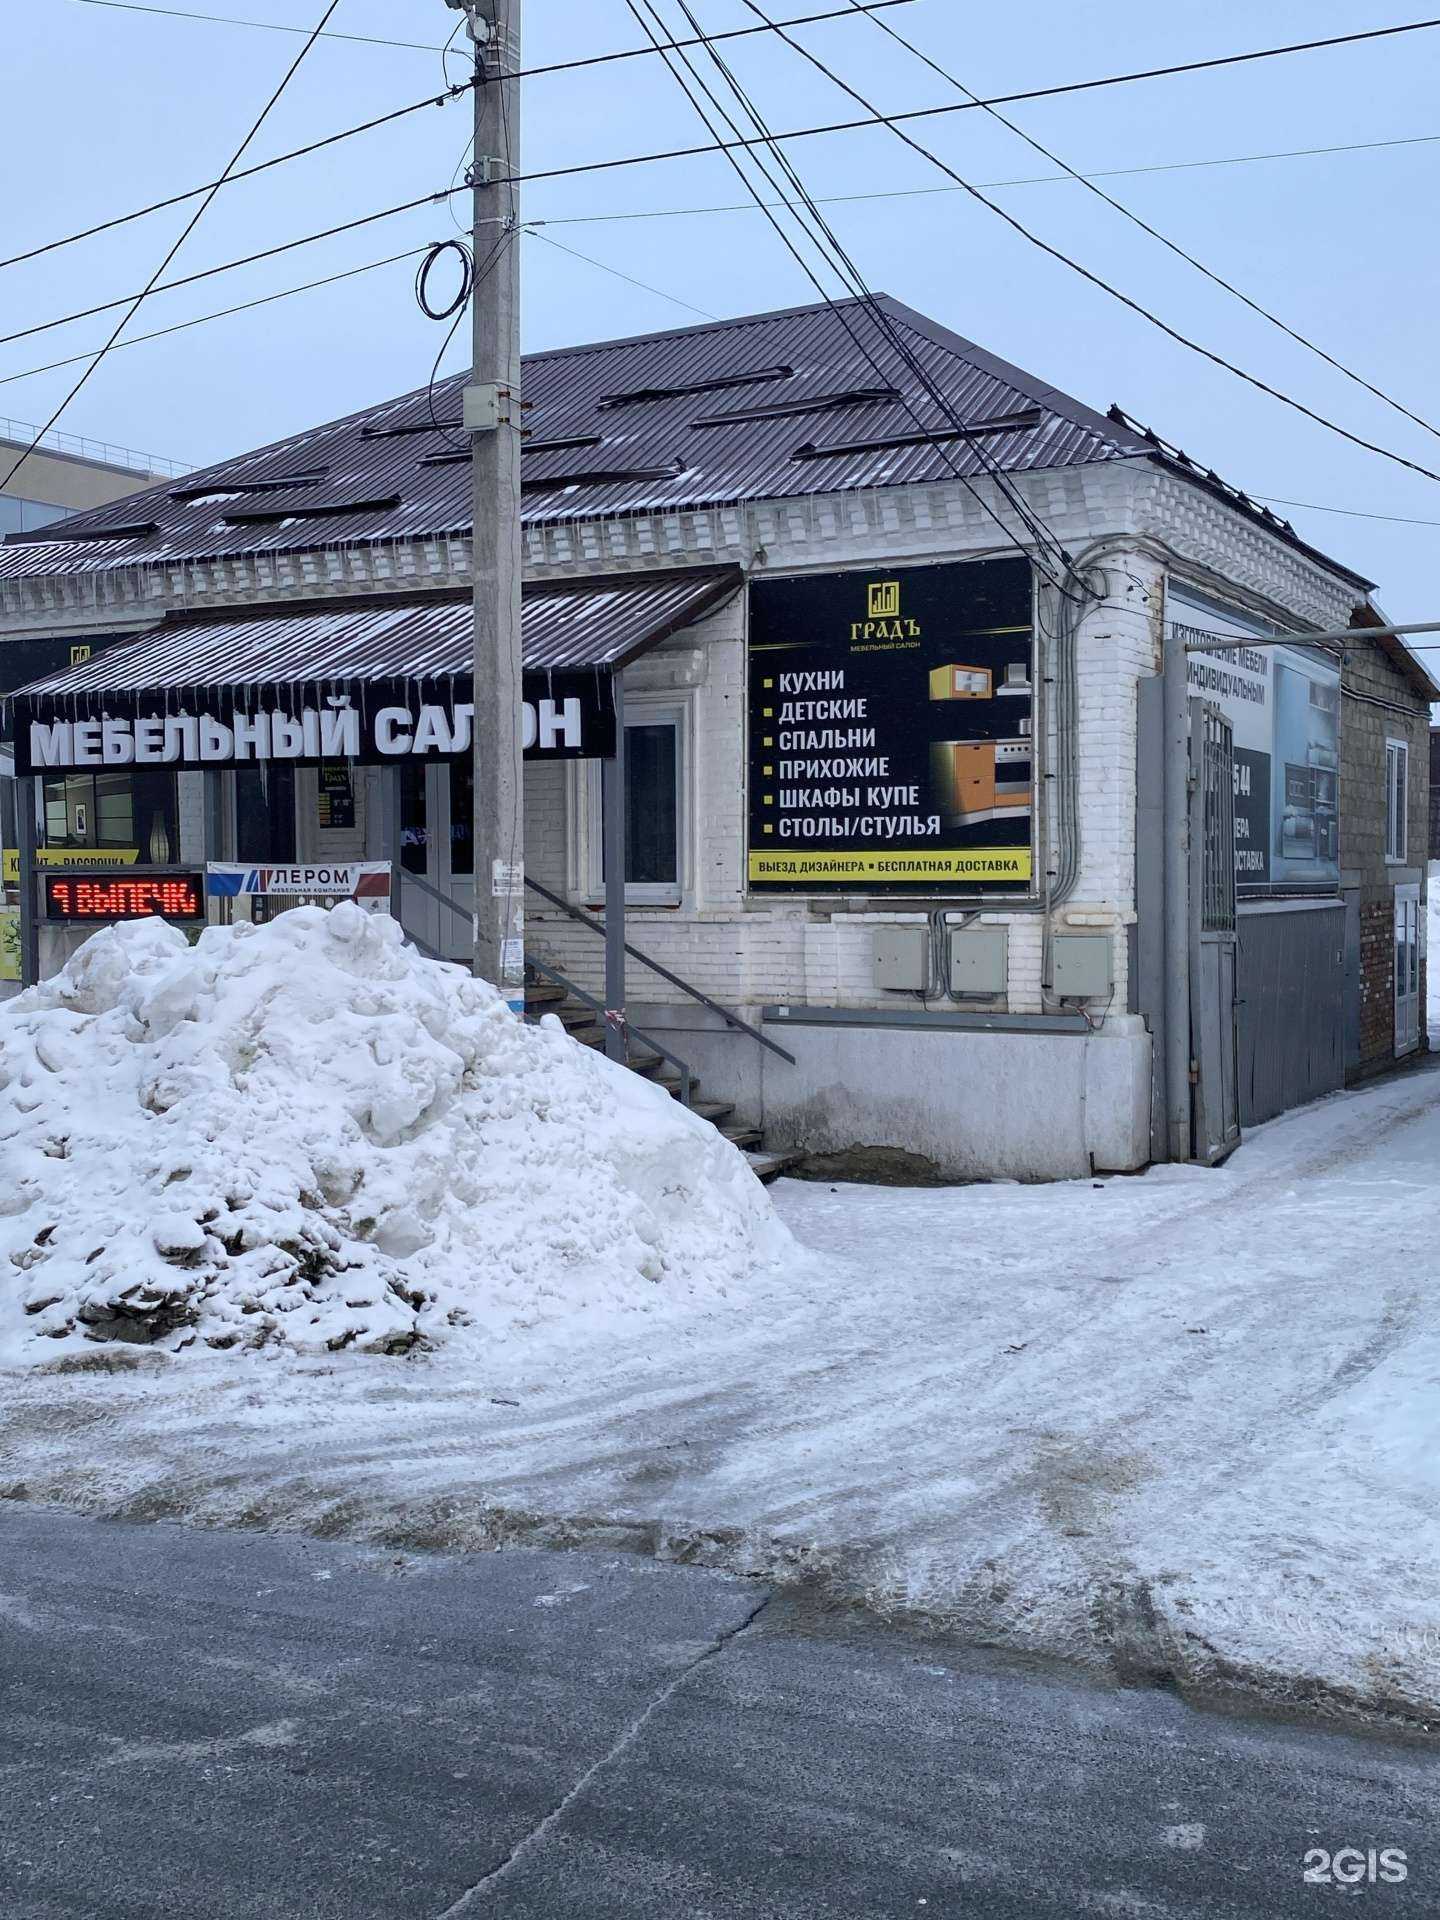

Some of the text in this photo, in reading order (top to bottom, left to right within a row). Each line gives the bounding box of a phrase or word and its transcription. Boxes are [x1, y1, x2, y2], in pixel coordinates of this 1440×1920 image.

[850, 619, 921, 640] ГРАДЪ
[779, 670, 845, 695] КУХНИ
[778, 698, 868, 725] ДЕТСКИЕ
[30, 695, 360, 767] МЕБЕЛЬНЫЙ
[778, 728, 876, 751] СПАЛЬНИ
[779, 757, 890, 779] ПРИХОЖИЕ
[779, 786, 920, 809] ШКАФЫ КУПЕ
[779, 815, 942, 839] СТОЛЫ/СТУЛЬЯ
[274, 869, 349, 884] ЛЕРОМ
[758, 860, 1019, 875] ВЫЕЗД ДИЗАЙНЕРА БЕСПЛАТНАЯ ДОСТАВКА
[271, 886, 351, 894] МЕБЕЛЬНАЯ КОМПАНИЯ
